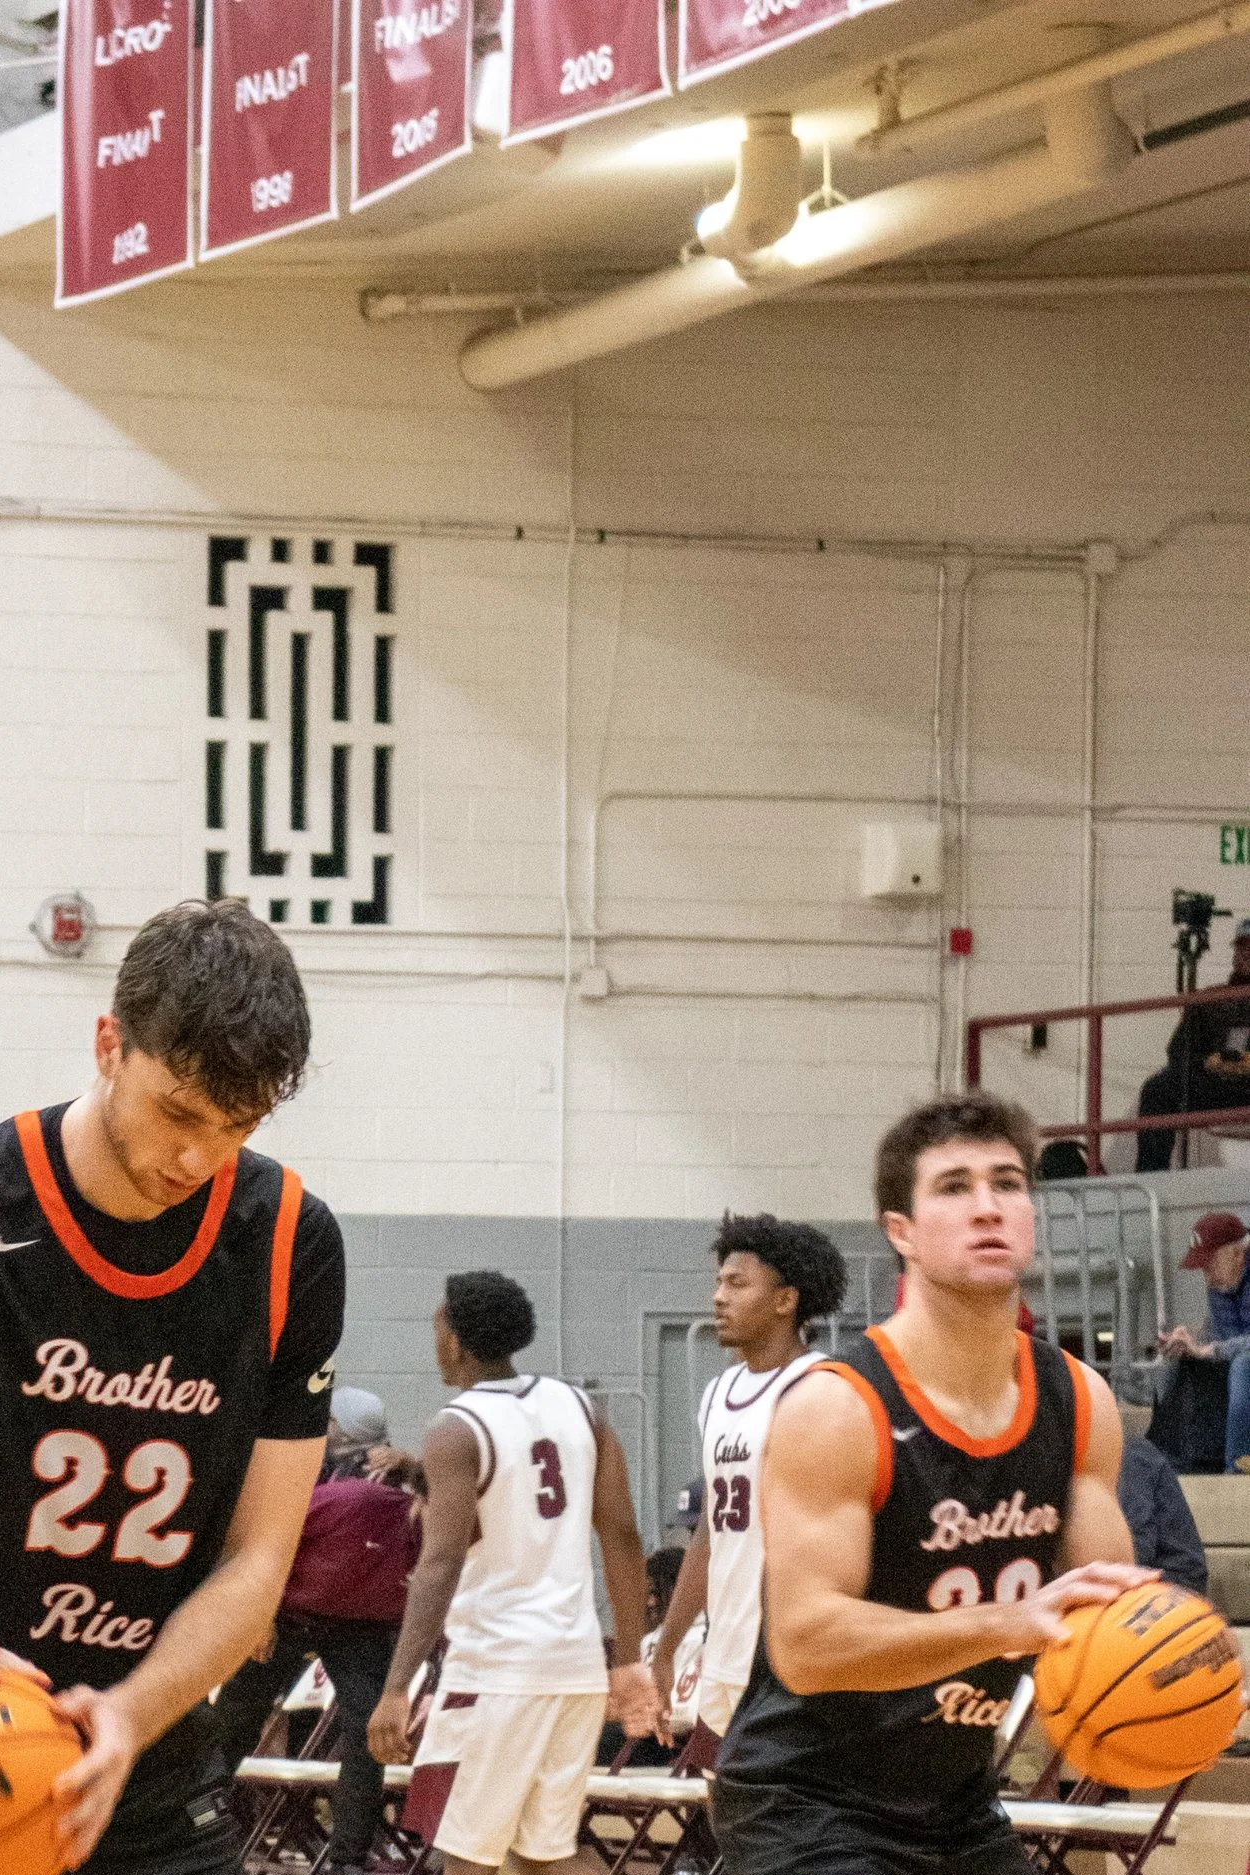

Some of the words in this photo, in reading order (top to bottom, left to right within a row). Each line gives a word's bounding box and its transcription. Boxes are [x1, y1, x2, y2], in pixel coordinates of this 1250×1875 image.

[22, 1338, 221, 1415] Brother
[530, 1438, 565, 1521] 3
[714, 1432, 751, 1467] Cubs
[24, 1429, 196, 1568] 22
[712, 1474, 751, 1533] 23
[919, 1489, 1060, 1552] Brother
[30, 1583, 153, 1652] Rice
